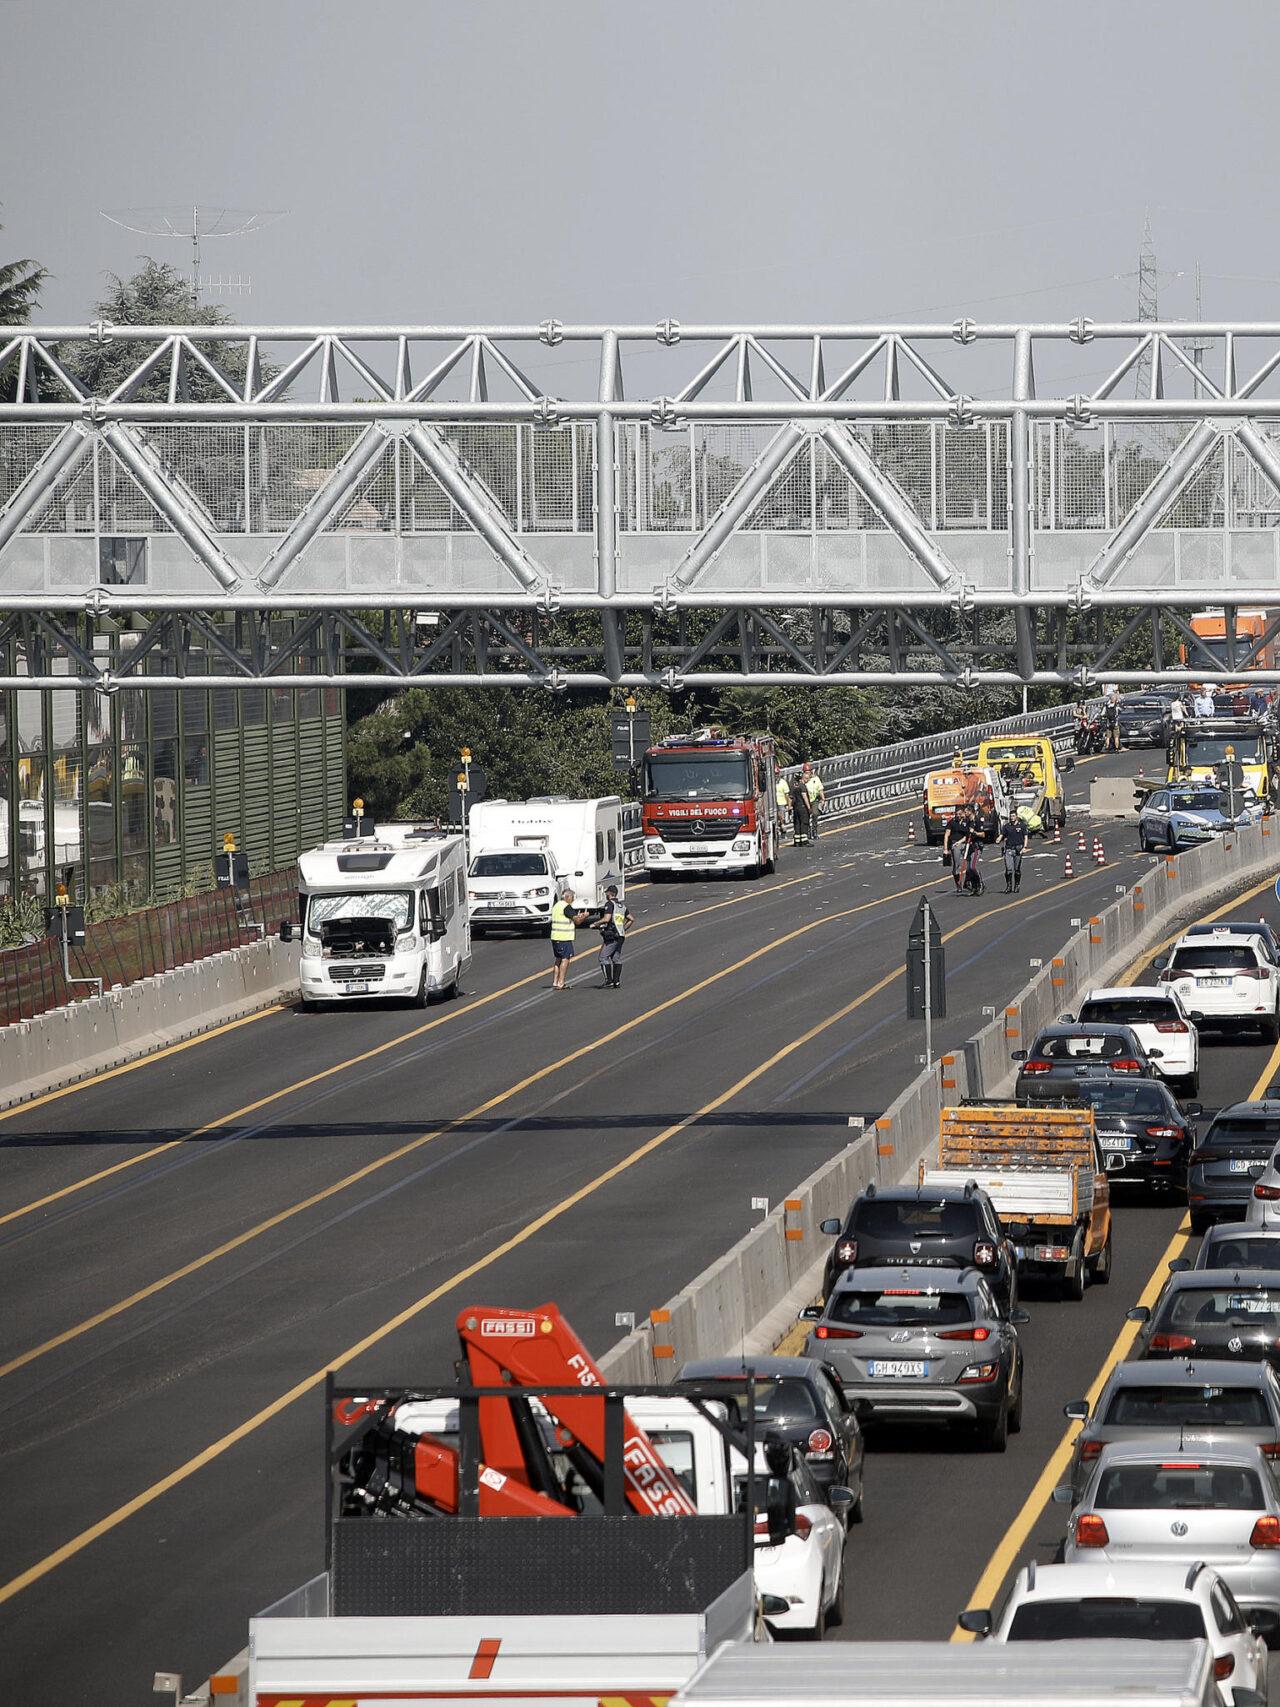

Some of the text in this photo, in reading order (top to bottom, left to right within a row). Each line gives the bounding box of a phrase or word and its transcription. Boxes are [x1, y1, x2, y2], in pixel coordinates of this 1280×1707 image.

[668, 807, 728, 817] VIGILI DEL FUOCO
[485, 1322, 532, 1334] FASSI
[624, 1448, 682, 1516] FASS
